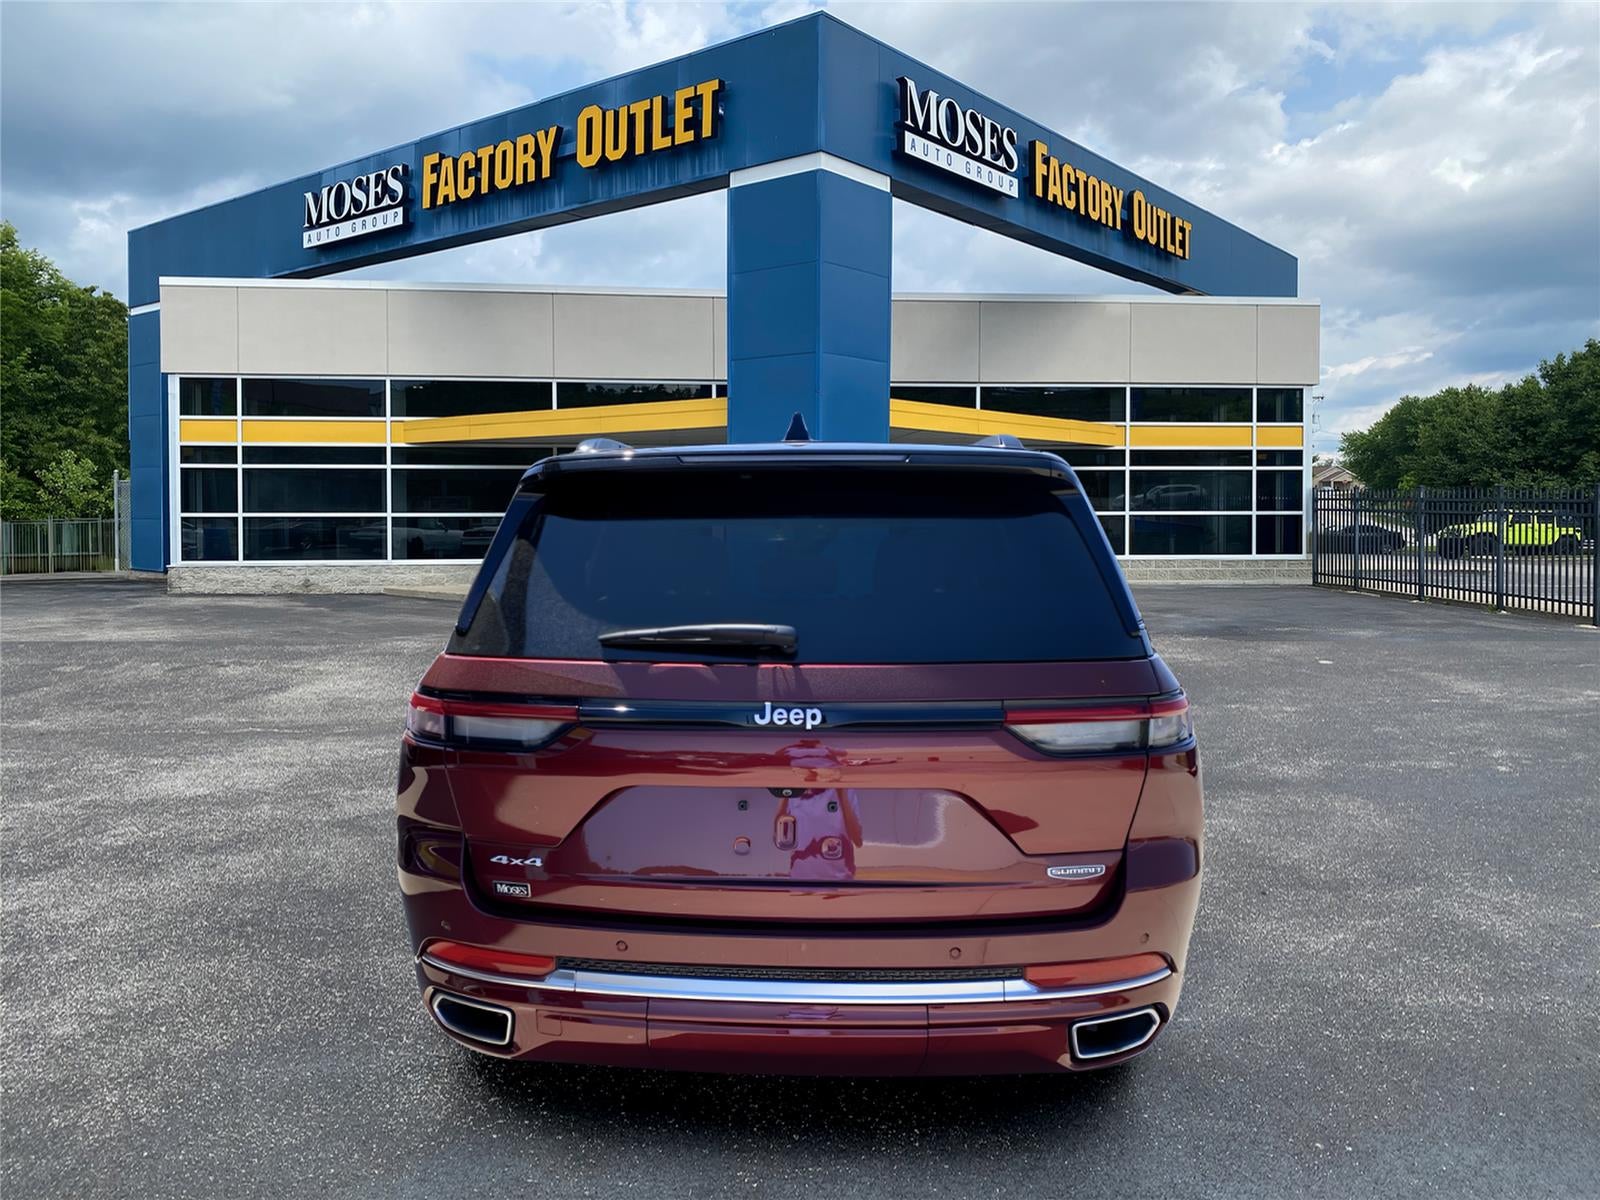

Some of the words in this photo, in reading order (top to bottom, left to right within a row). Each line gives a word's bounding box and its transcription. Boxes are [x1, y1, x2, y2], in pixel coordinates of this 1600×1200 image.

[422, 125, 560, 209] FACTORY
[576, 79, 721, 169] OUTLET
[903, 76, 1019, 173] MOSES
[910, 137, 953, 168] AUTO
[965, 157, 1015, 193] GROUP
[303, 165, 404, 228] MOSES
[1034, 140, 1124, 231] FACTORY
[1131, 190, 1193, 260] OUTLET
[307, 225, 341, 245] AUTO
[350, 210, 400, 233] GROUP
[754, 702, 822, 730] Jeep
[490, 855, 543, 867] 4x4
[496, 883, 527, 895] MOSES
